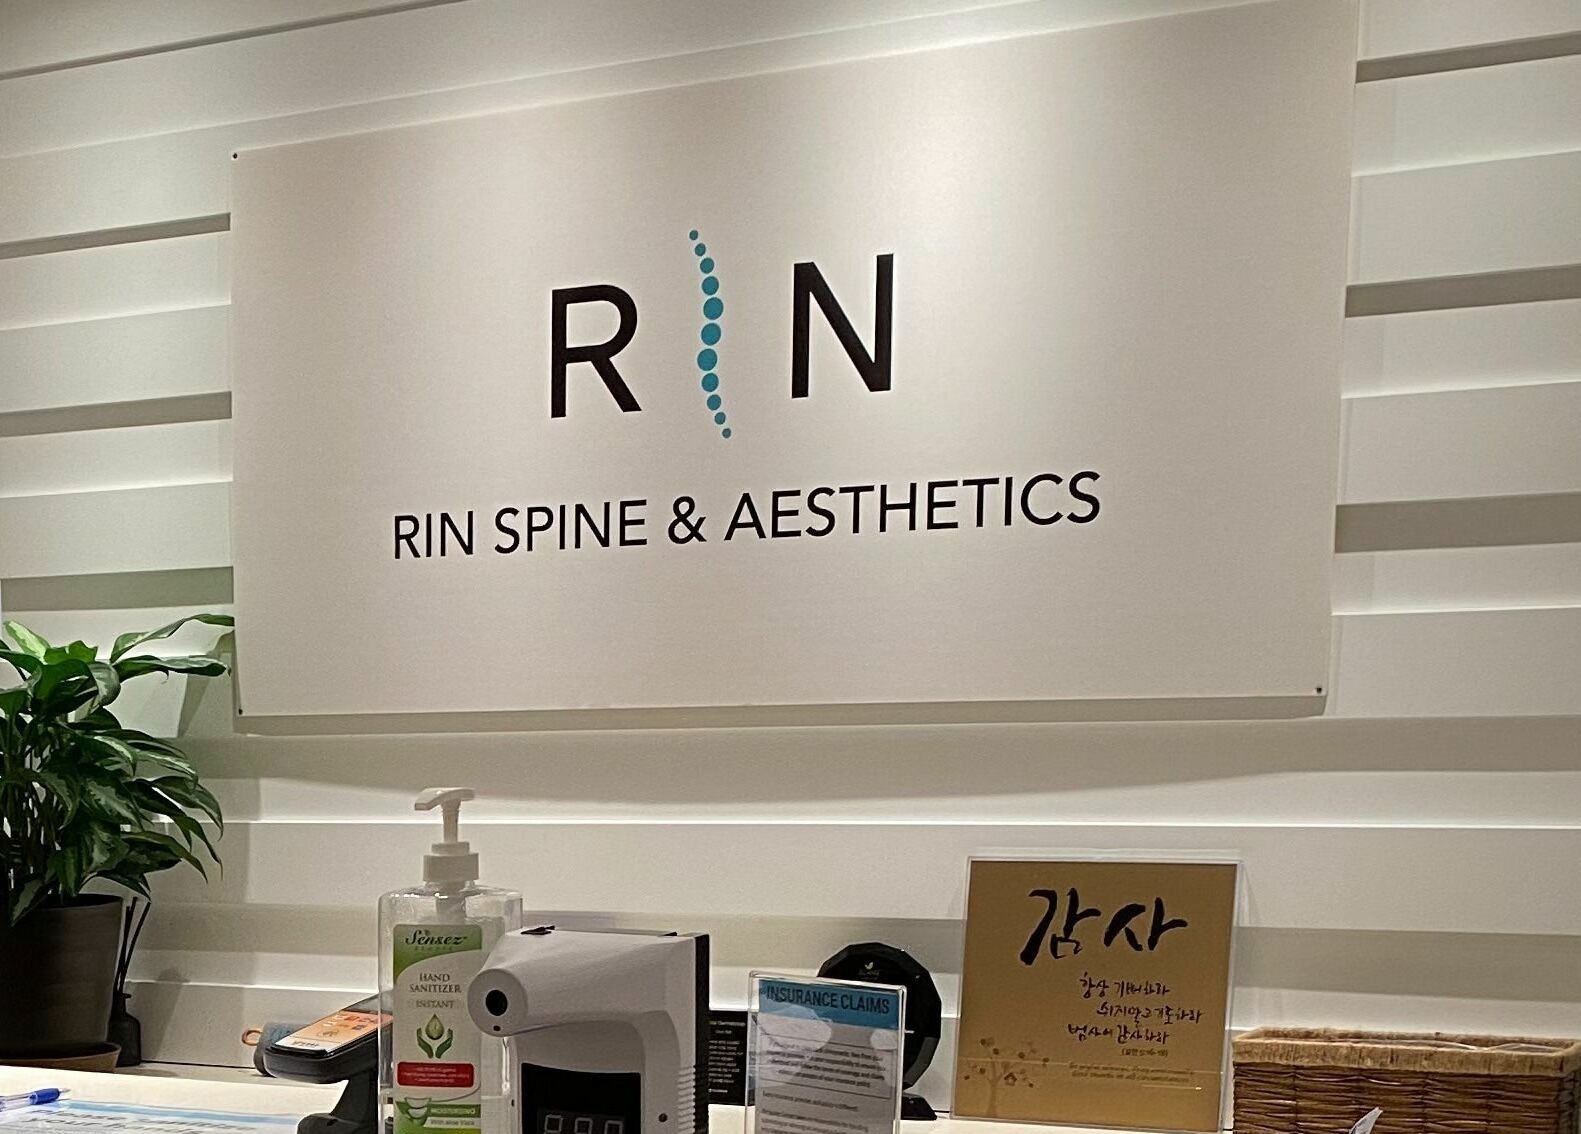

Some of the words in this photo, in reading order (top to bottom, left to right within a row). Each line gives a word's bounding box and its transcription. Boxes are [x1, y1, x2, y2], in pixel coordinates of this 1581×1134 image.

[393, 510, 476, 559] RIN
[493, 498, 648, 554] SPINE
[667, 495, 708, 546] &
[723, 470, 1102, 542] AESTHETICS
[1020, 887, 1189, 966] 감사
[409, 984, 462, 993] SANITIZER
[419, 972, 450, 983] HAND
[1080, 971, 1110, 999] 항상
[416, 1000, 454, 1009] INSTANT
[766, 985, 838, 1009] INSURANCE
[840, 994, 891, 1015] CLAIMS
[22, 1117, 103, 1127] your
[102, 1122, 205, 1134] hands
